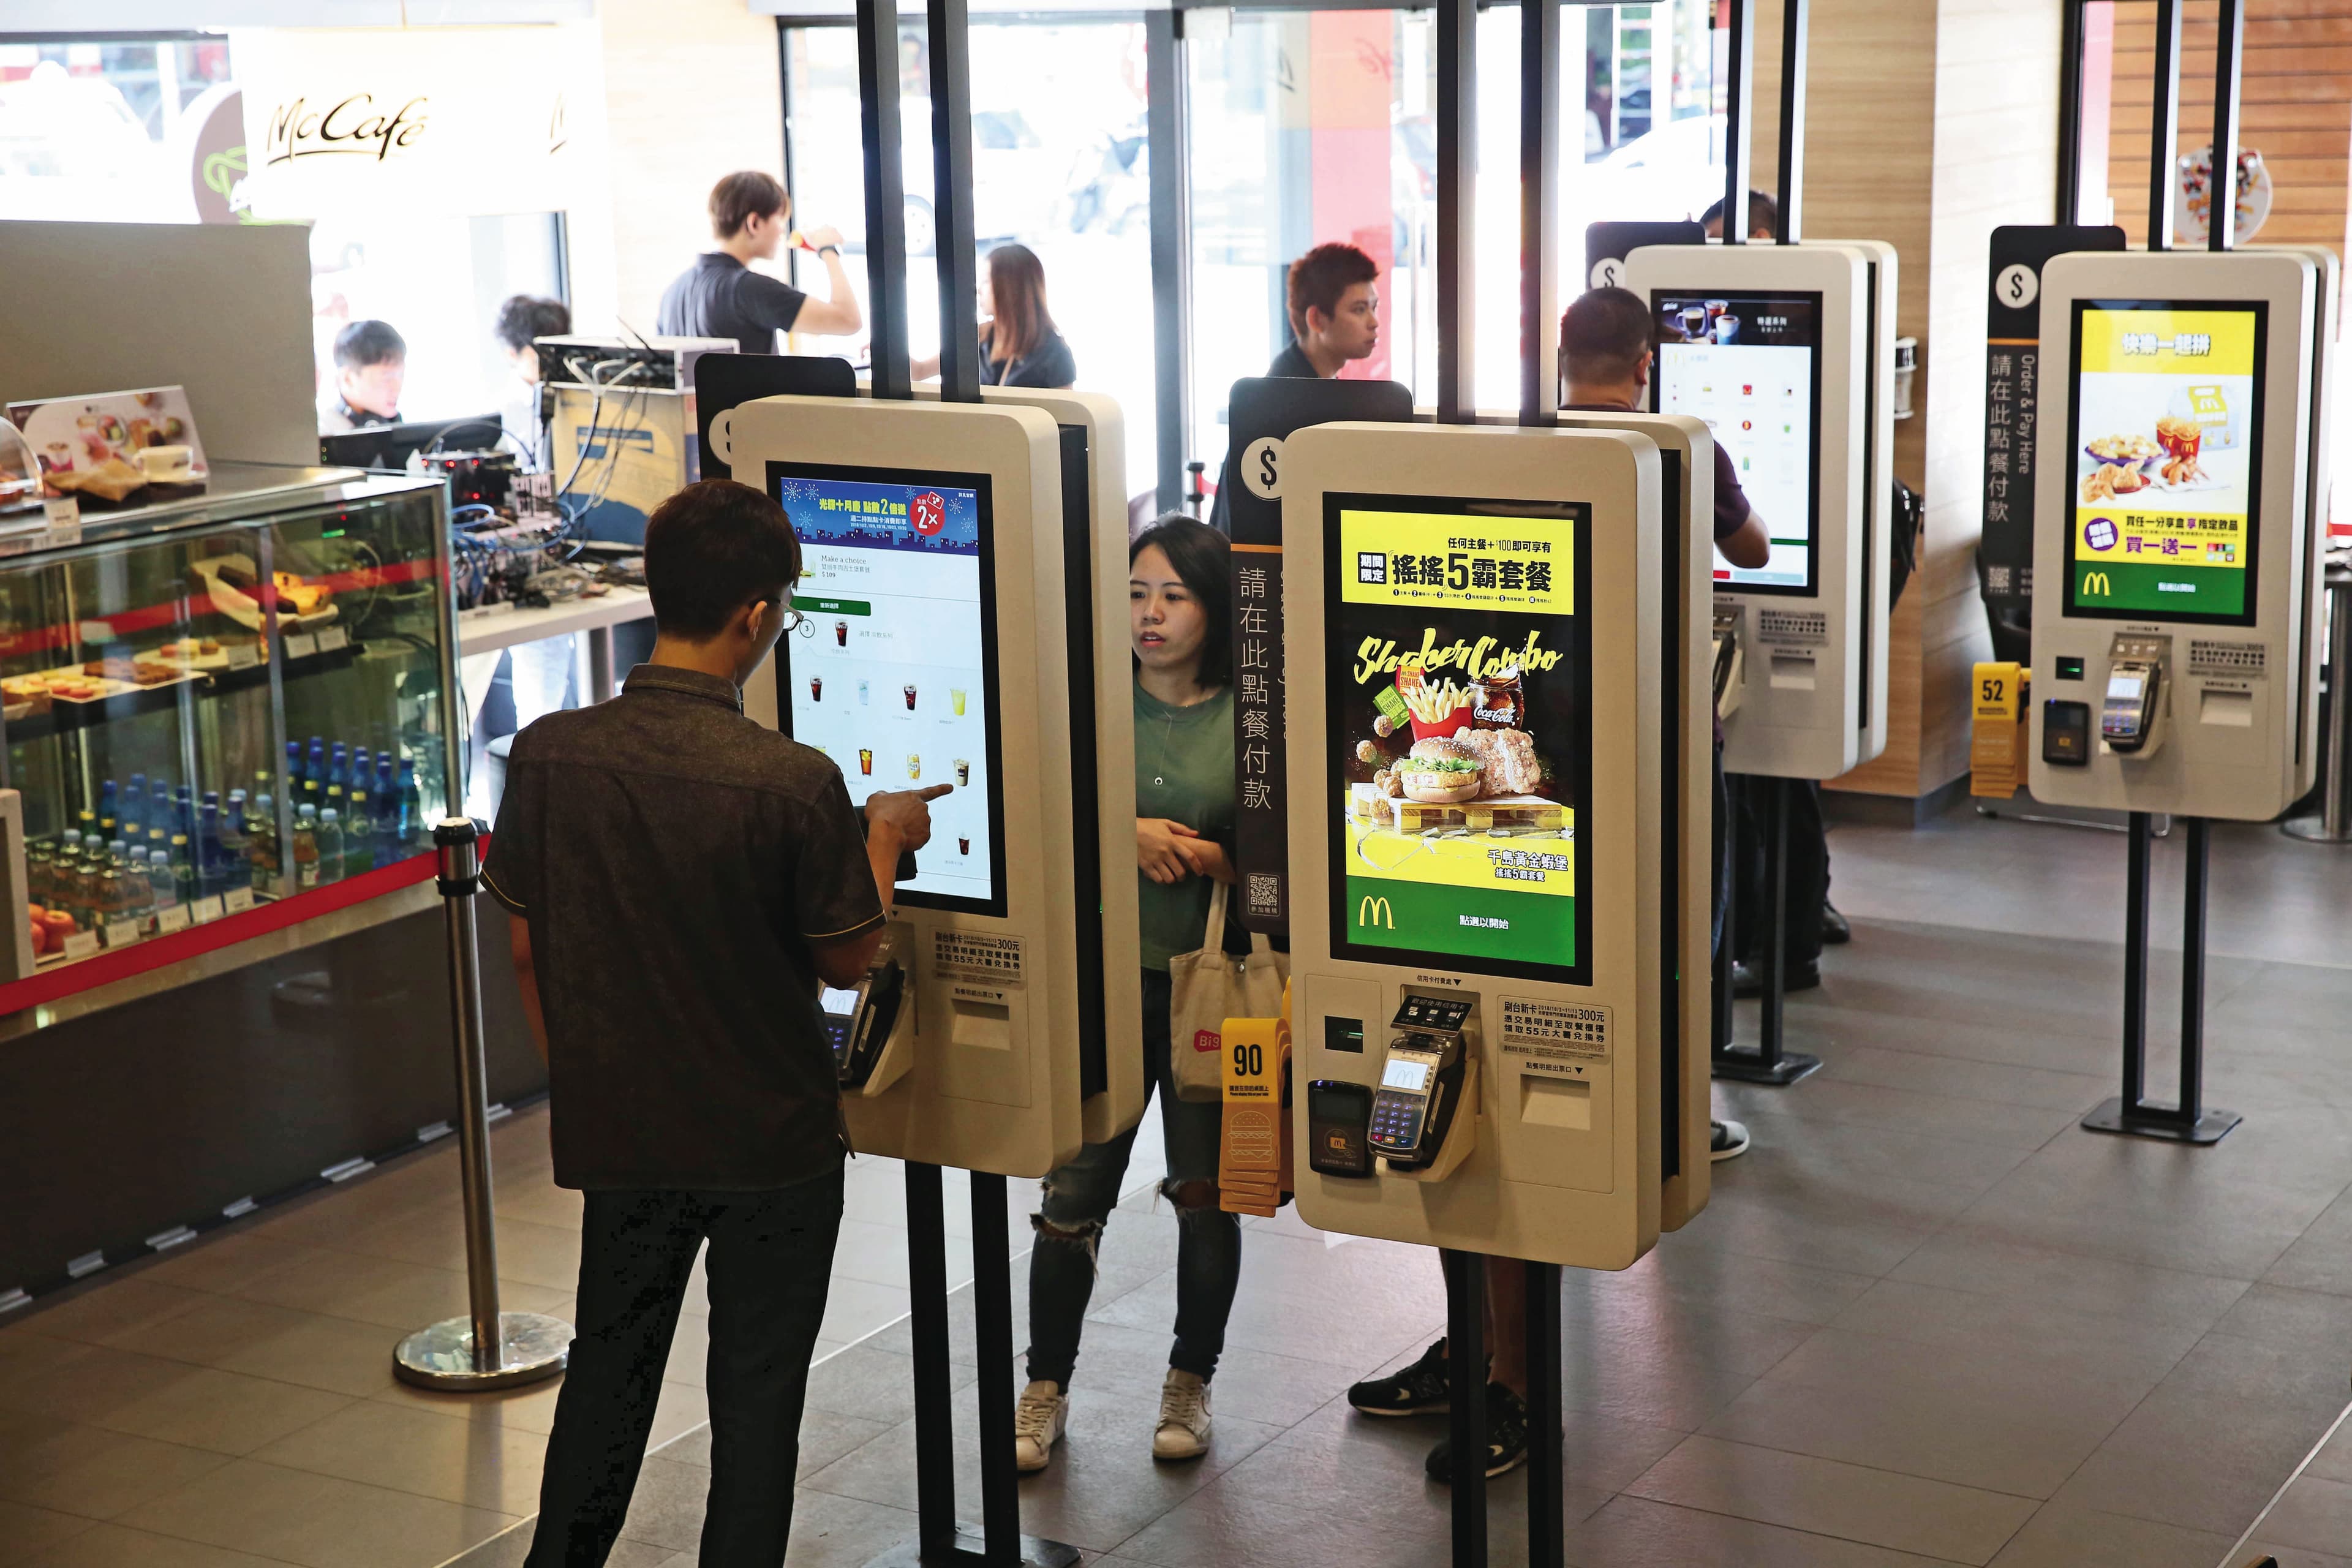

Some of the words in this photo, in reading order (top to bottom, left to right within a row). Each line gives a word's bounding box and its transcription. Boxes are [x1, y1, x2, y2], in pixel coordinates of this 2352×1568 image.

[2021, 354, 2035, 394] Order
[2020, 398, 2034, 409] &
[2016, 412, 2034, 439] Pay
[1988, 354, 2012, 522] 請在此點餐付款
[2018, 441, 2033, 474] Here
[2126, 536, 2197, 555] 買一送一
[1360, 554, 1384, 568] 期間
[1360, 568, 1385, 582] 限定
[1392, 552, 1552, 592] 搖搖5霸套餐
[1354, 628, 1473, 685] Shaker
[1468, 630, 1563, 679] Combo
[1239, 567, 1271, 810] 請在此點餐付款
[1982, 680, 2003, 701] 52
[1488, 849, 1569, 872] 千島黃金蝦堡
[1495, 867, 1545, 883] 搖搖5霸套餐
[1459, 914, 1509, 930] 點選以開始
[997, 938, 1020, 951] 300元
[1417, 974, 1452, 985] 信用卡付費處
[1504, 1001, 1537, 1015] 刷台新卡
[1578, 1009, 1605, 1022] 300元
[1234, 1044, 1262, 1076] 90
[1526, 1061, 1572, 1072] 點餐明細出票口
